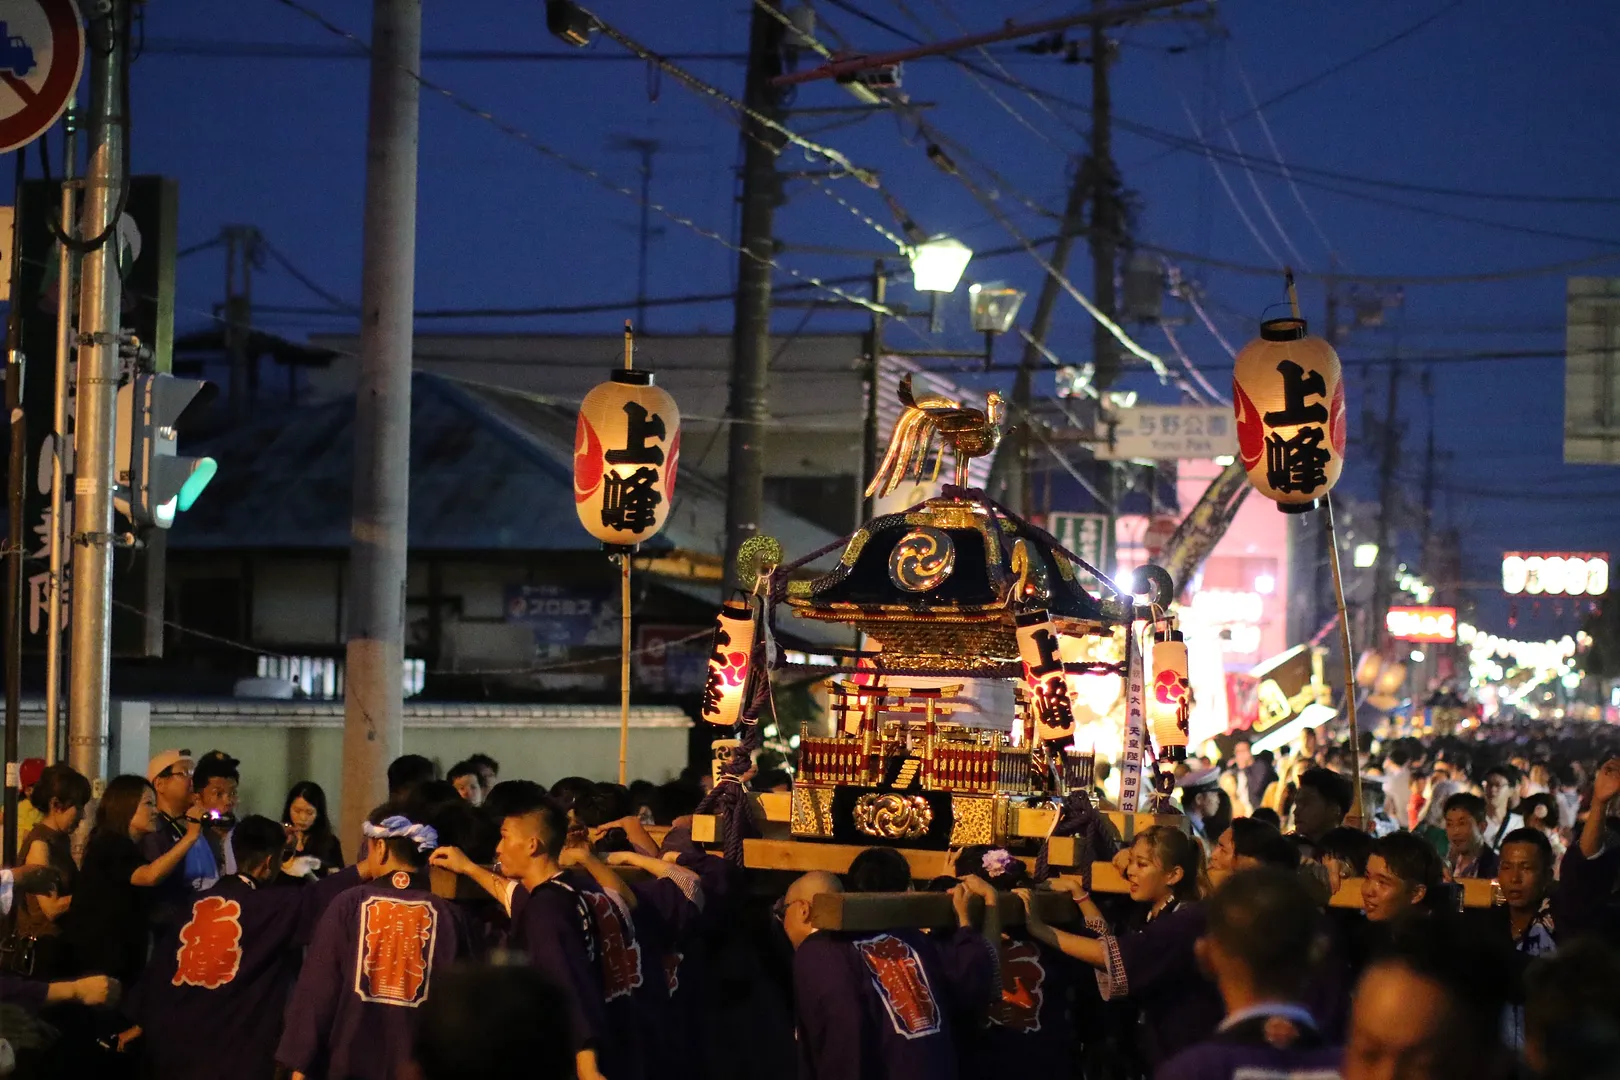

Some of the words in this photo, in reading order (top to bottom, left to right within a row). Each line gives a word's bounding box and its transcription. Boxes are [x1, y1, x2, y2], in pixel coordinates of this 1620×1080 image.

[601, 401, 666, 534] 上峰
[1263, 359, 1332, 495] 上峰
[1029, 628, 1074, 730] 上峰
[1122, 726, 1141, 812] 天皇陛下御即位
